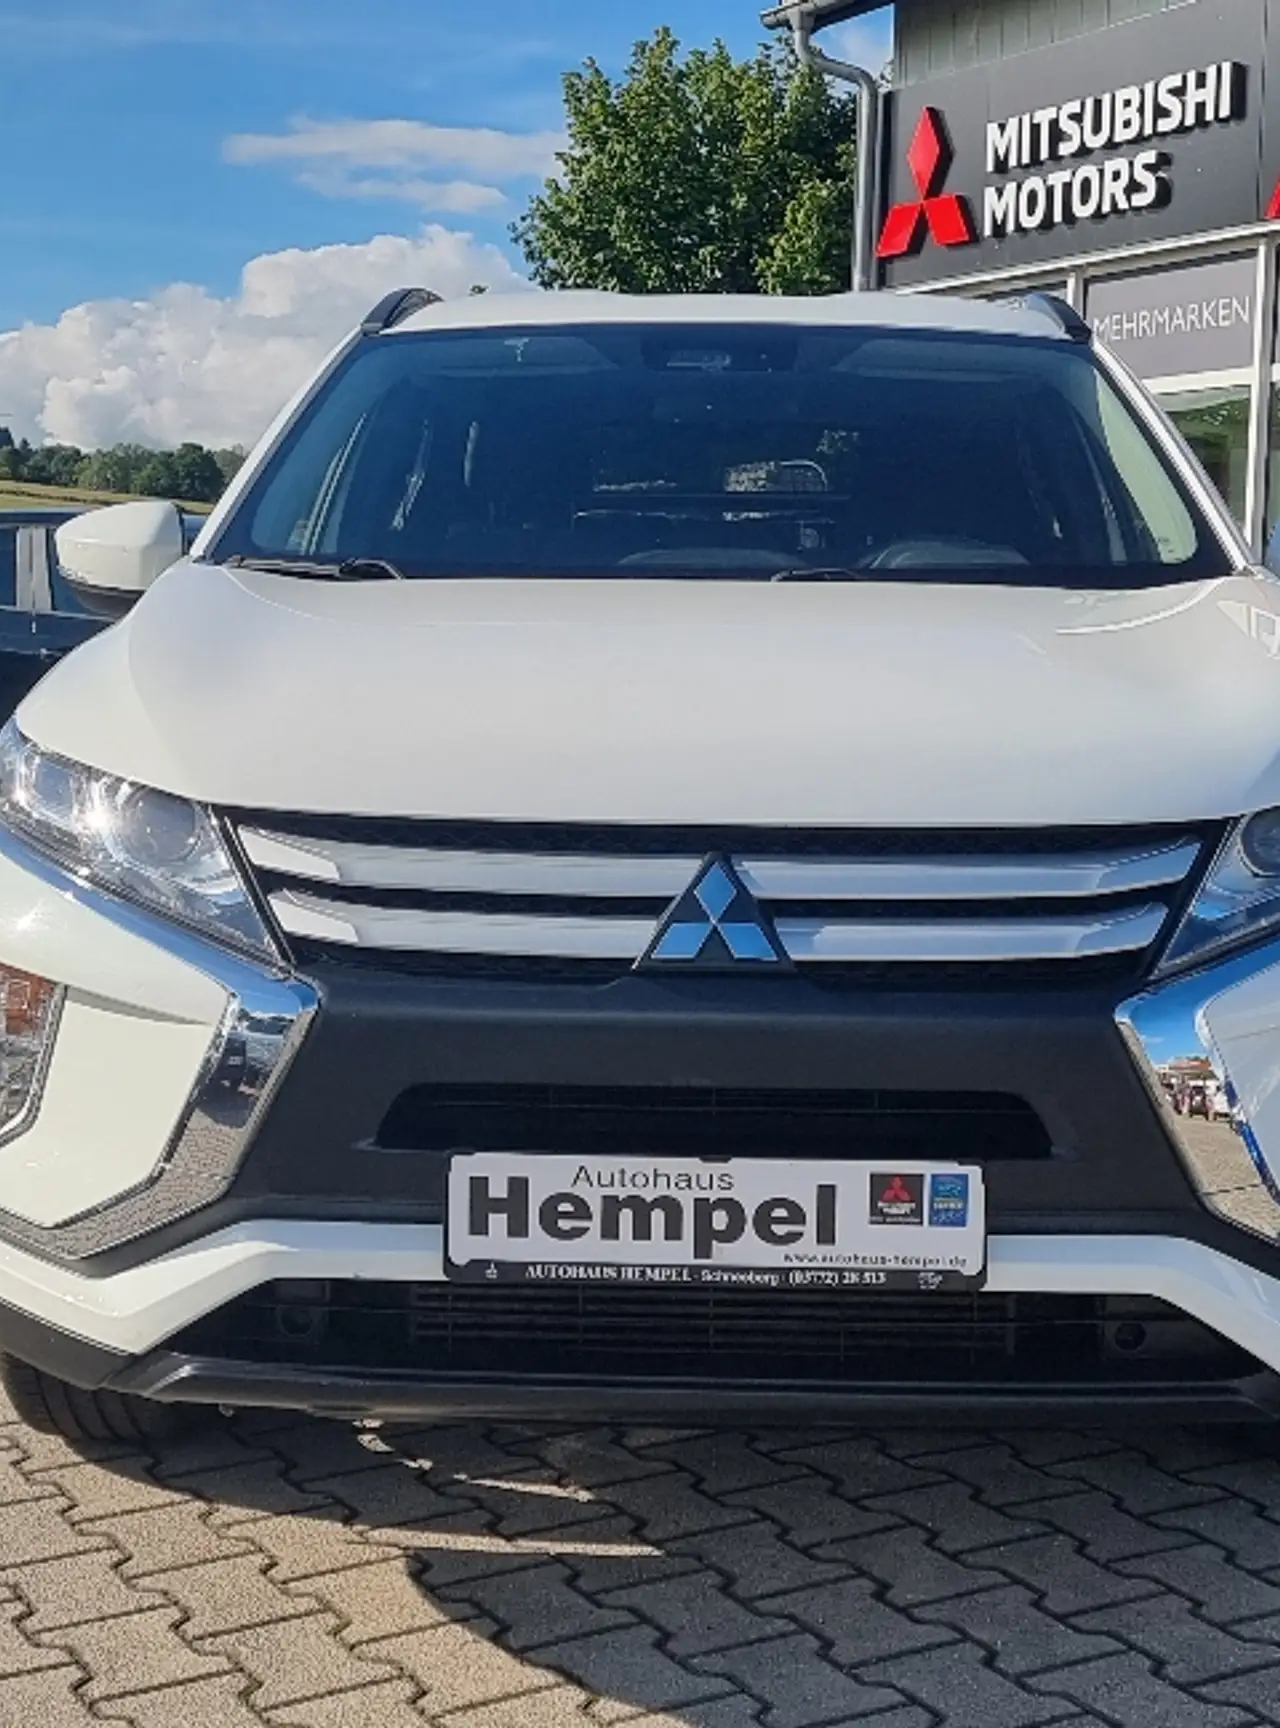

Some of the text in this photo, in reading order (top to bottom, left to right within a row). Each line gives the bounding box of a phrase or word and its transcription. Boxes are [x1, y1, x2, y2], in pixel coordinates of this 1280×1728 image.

[985, 61, 1233, 173] MITSUBISHI
[983, 150, 1158, 237] MOTORS
[1092, 295, 1251, 342] MEHRMARKEN
[570, 1165, 736, 1191] Autohaus
[468, 1175, 837, 1260] Hempel
[524, 1264, 618, 1280] AUTOHAUS
[620, 1265, 692, 1282] HEMPEL
[701, 1270, 779, 1287] Schneeberg
